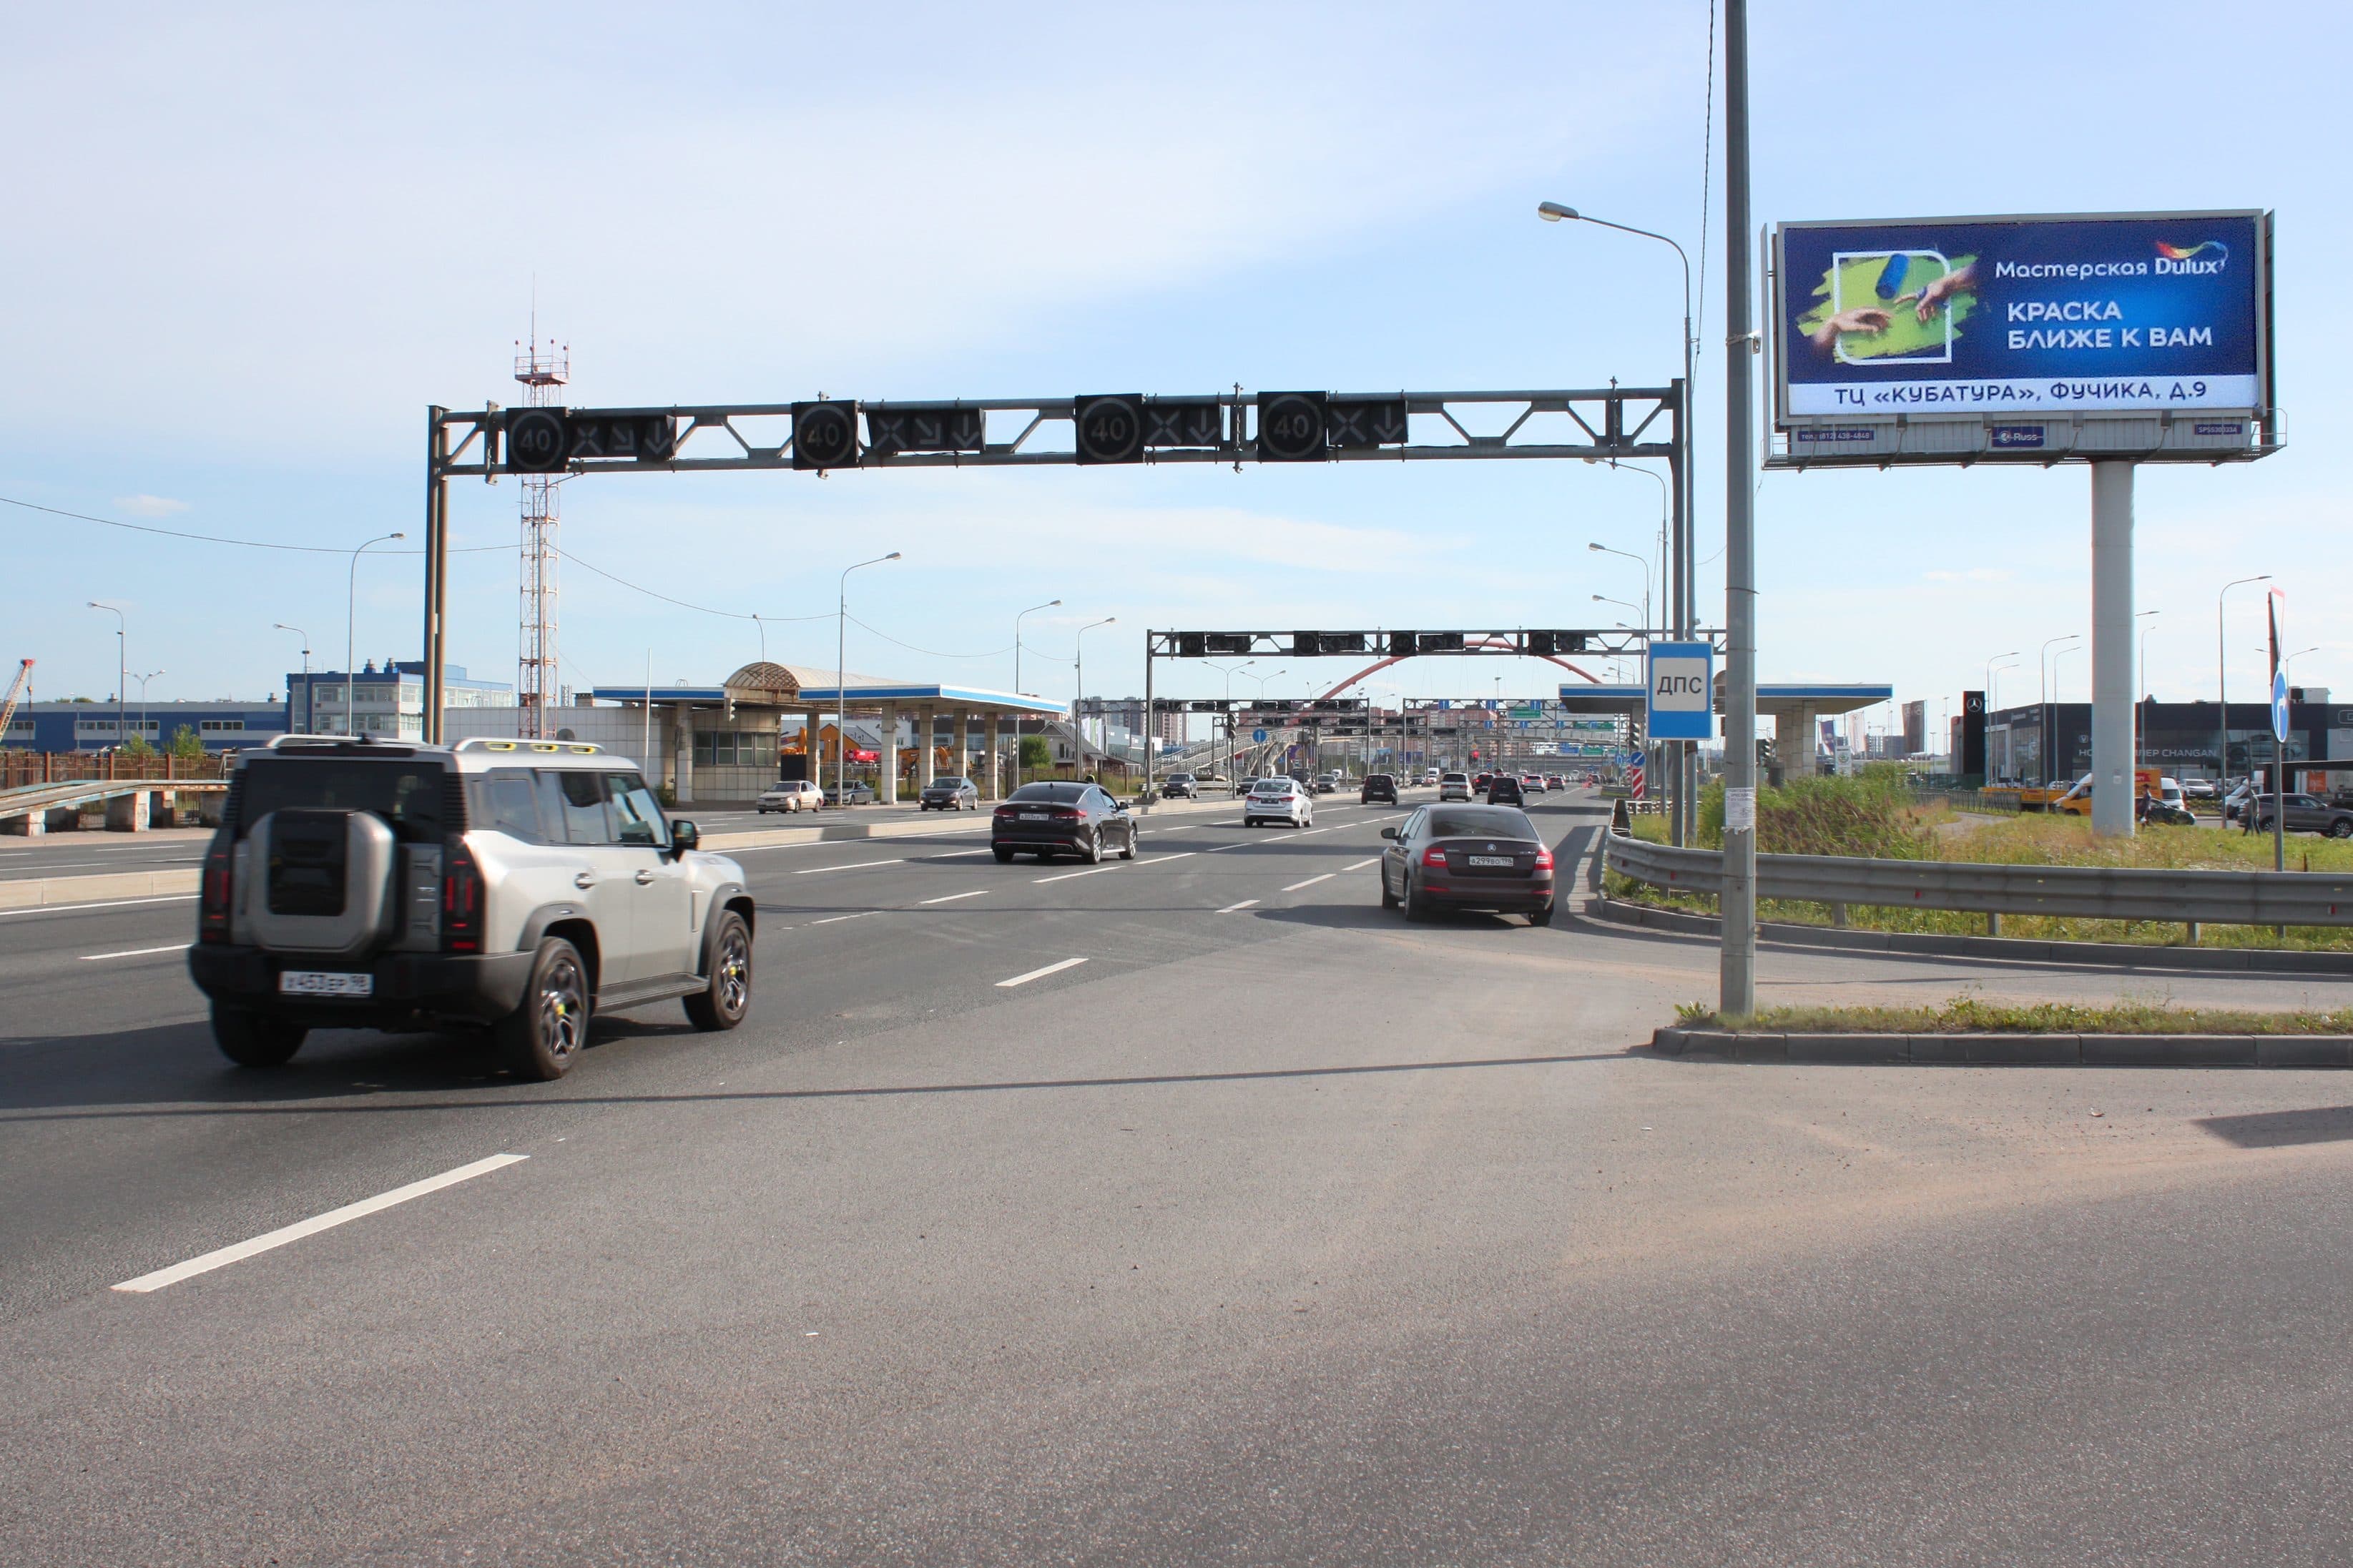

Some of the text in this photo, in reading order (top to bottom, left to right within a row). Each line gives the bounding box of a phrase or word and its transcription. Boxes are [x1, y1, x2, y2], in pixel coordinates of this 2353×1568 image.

[1995, 257, 2219, 280] Мастерская Dulux
[2008, 301, 2123, 322] КРАСКА
[2008, 326, 2213, 350] БЛИЖЕ К ВАМ
[1834, 381, 2206, 406] ТЦ «КУБАТУРА», ФУЧИКА, Д.9
[807, 422, 840, 447] 40
[1091, 417, 1126, 441] 40
[1273, 414, 1310, 439] 40
[2013, 433, 2037, 441] Russ
[520, 428, 551, 452] 40
[1656, 676, 1701, 695] ДПС
